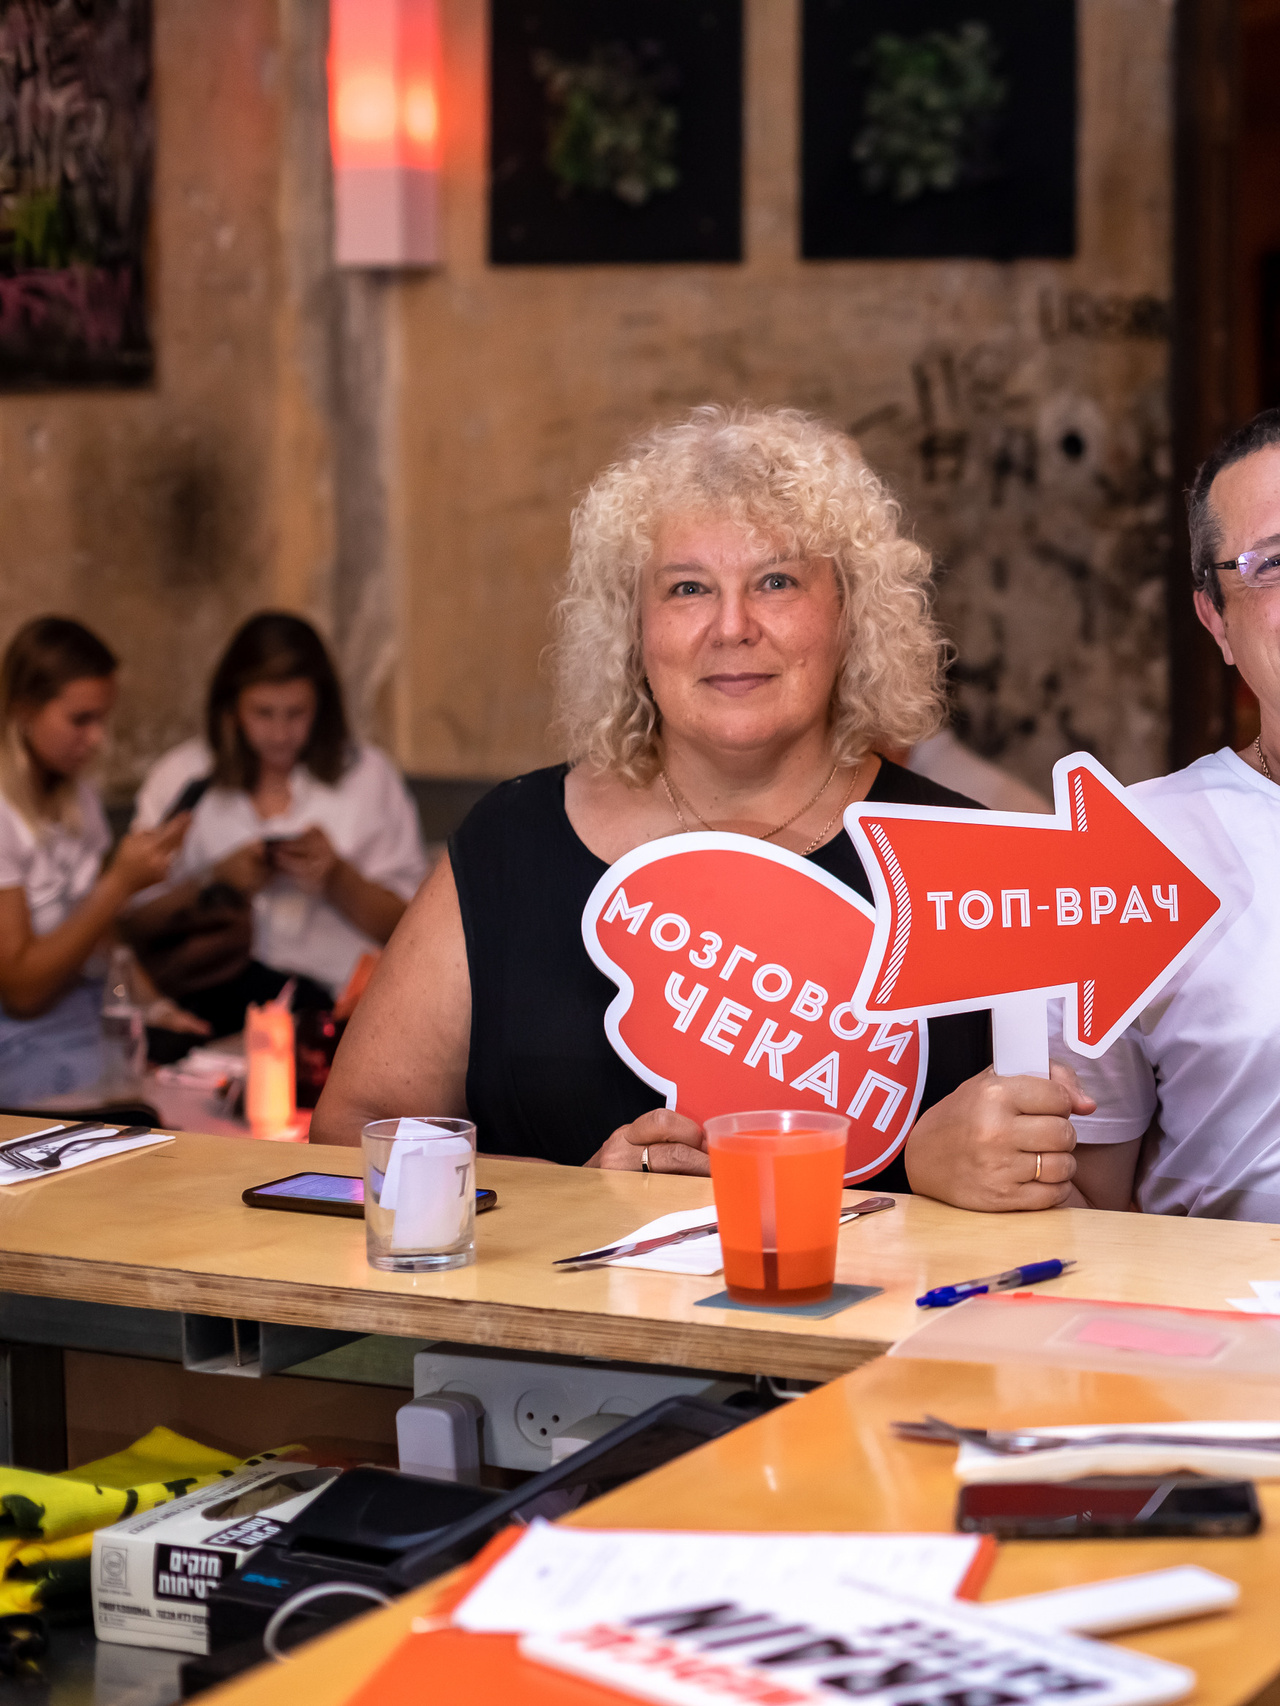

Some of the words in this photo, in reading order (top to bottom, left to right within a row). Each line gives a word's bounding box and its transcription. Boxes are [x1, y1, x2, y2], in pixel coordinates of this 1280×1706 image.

[928, 884, 1180, 931] ТОП-ВРАЧ
[602, 887, 914, 1066] МОЗГОВОЙ
[663, 971, 908, 1133] ЧЕКАП
[169, 1549, 222, 1578] חזקים
